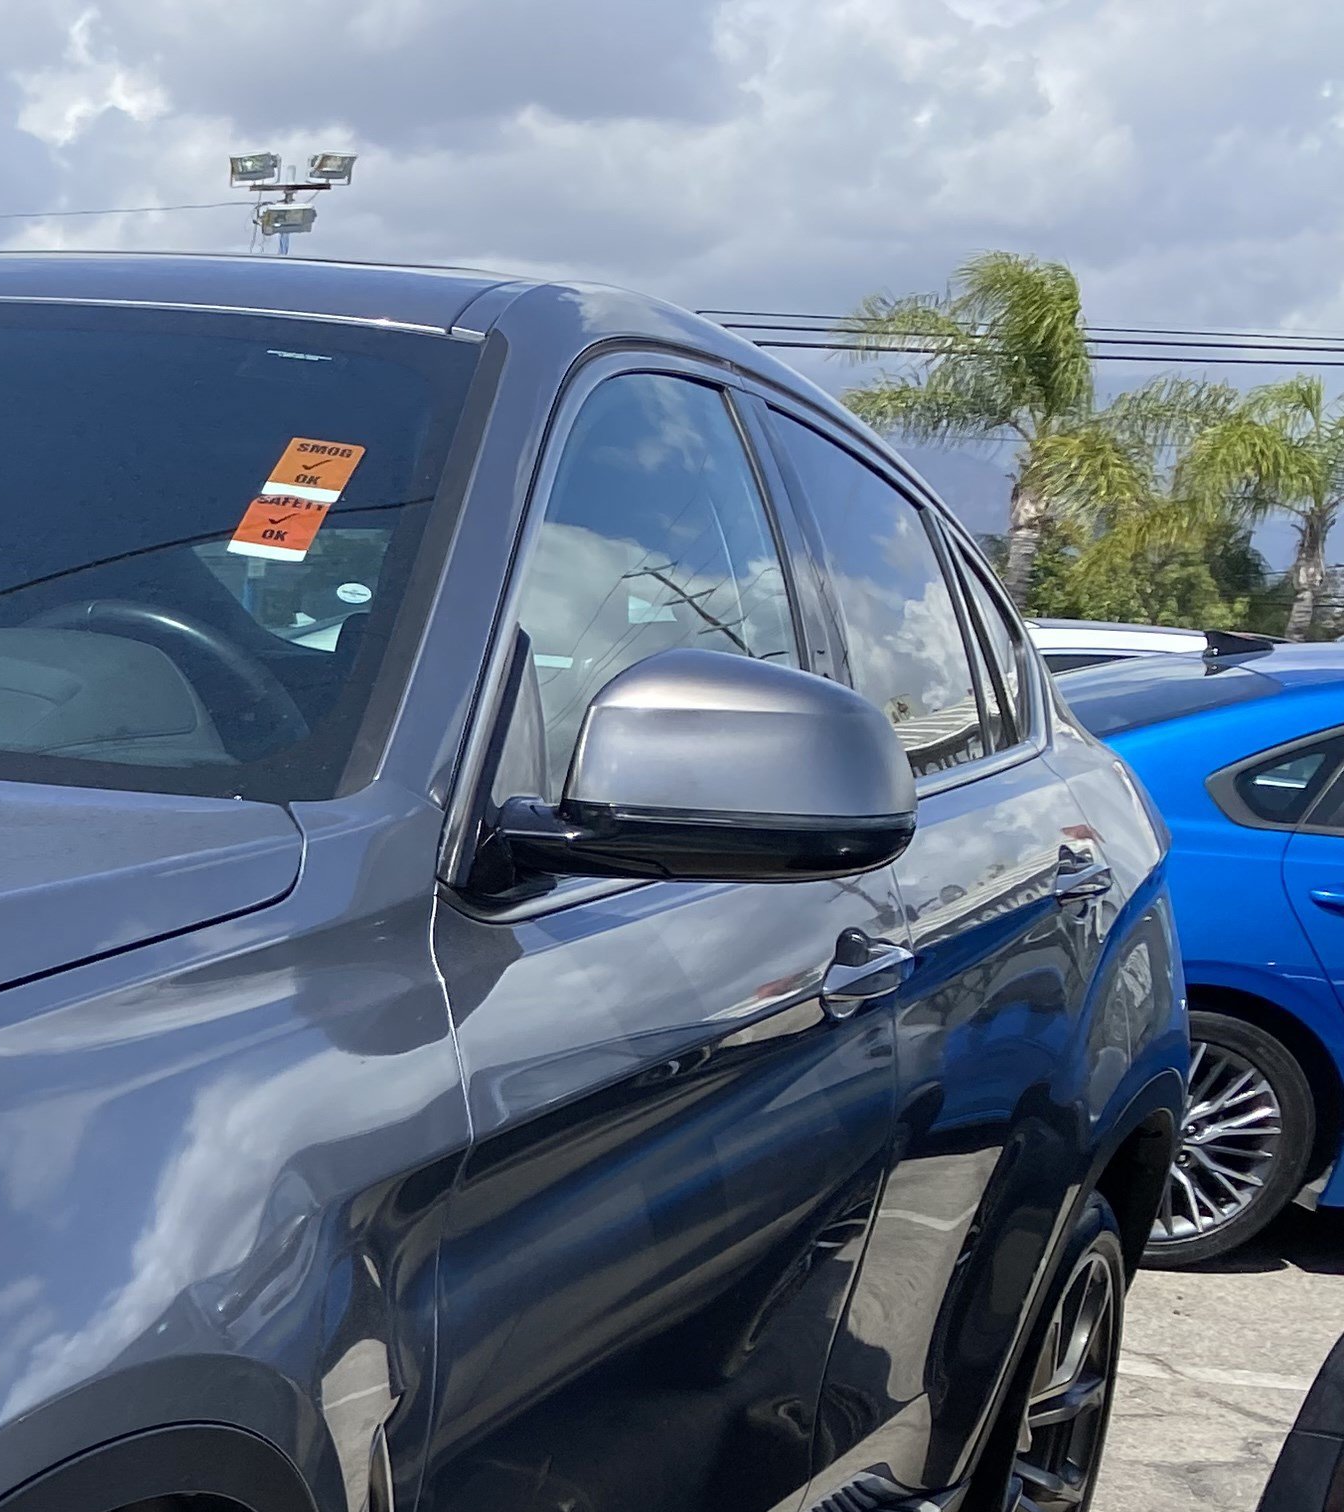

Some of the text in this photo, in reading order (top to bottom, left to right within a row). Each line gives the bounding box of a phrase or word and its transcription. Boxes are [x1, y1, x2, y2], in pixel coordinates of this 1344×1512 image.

[296, 442, 353, 458] SMOG
[294, 473, 321, 485] OK
[261, 528, 288, 542] OK
